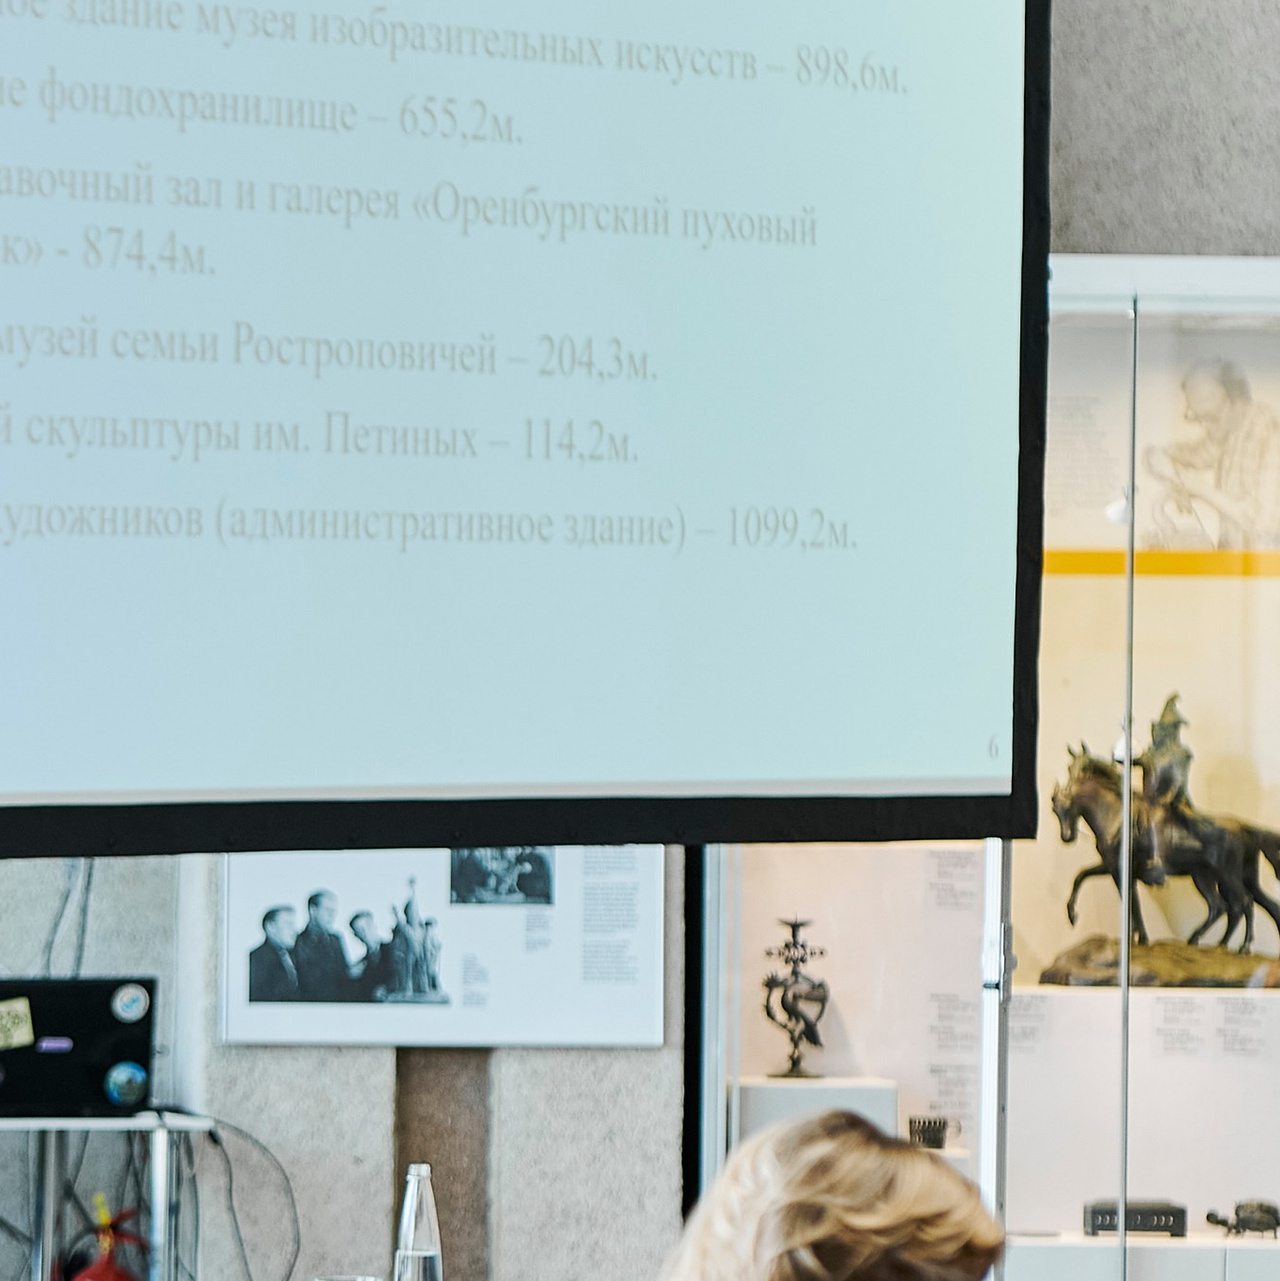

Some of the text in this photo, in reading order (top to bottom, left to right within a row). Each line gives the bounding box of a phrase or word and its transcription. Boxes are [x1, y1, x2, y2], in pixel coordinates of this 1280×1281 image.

[194, 0, 299, 50] музея
[309, 5, 604, 70] изобразительных
[613, 38, 759, 86] искусств
[795, 45, 909, 96] 898,6м.
[37, 64, 359, 138] фондохранилище
[398, 95, 524, 146] 655,2м.
[165, 170, 224, 213] зал
[234, 175, 258, 210] и
[266, 178, 402, 230] галерея
[411, 180, 670, 244] «Оренбургский
[682, 206, 819, 252] пуховый
[81, 223, 219, 279] 874,4м.
[110, 325, 220, 365] семьи
[231, 320, 498, 380] Ростроповичей
[536, 332, 659, 384] 204,3м.
[26, 410, 241, 462] скульптуры
[253, 415, 311, 455] им.
[322, 410, 479, 460] Петиных
[521, 415, 639, 468] 114,2м.
[215, 496, 554, 554] (административное
[564, 504, 687, 554] здание)
[724, 505, 858, 551] 1099,2м.
